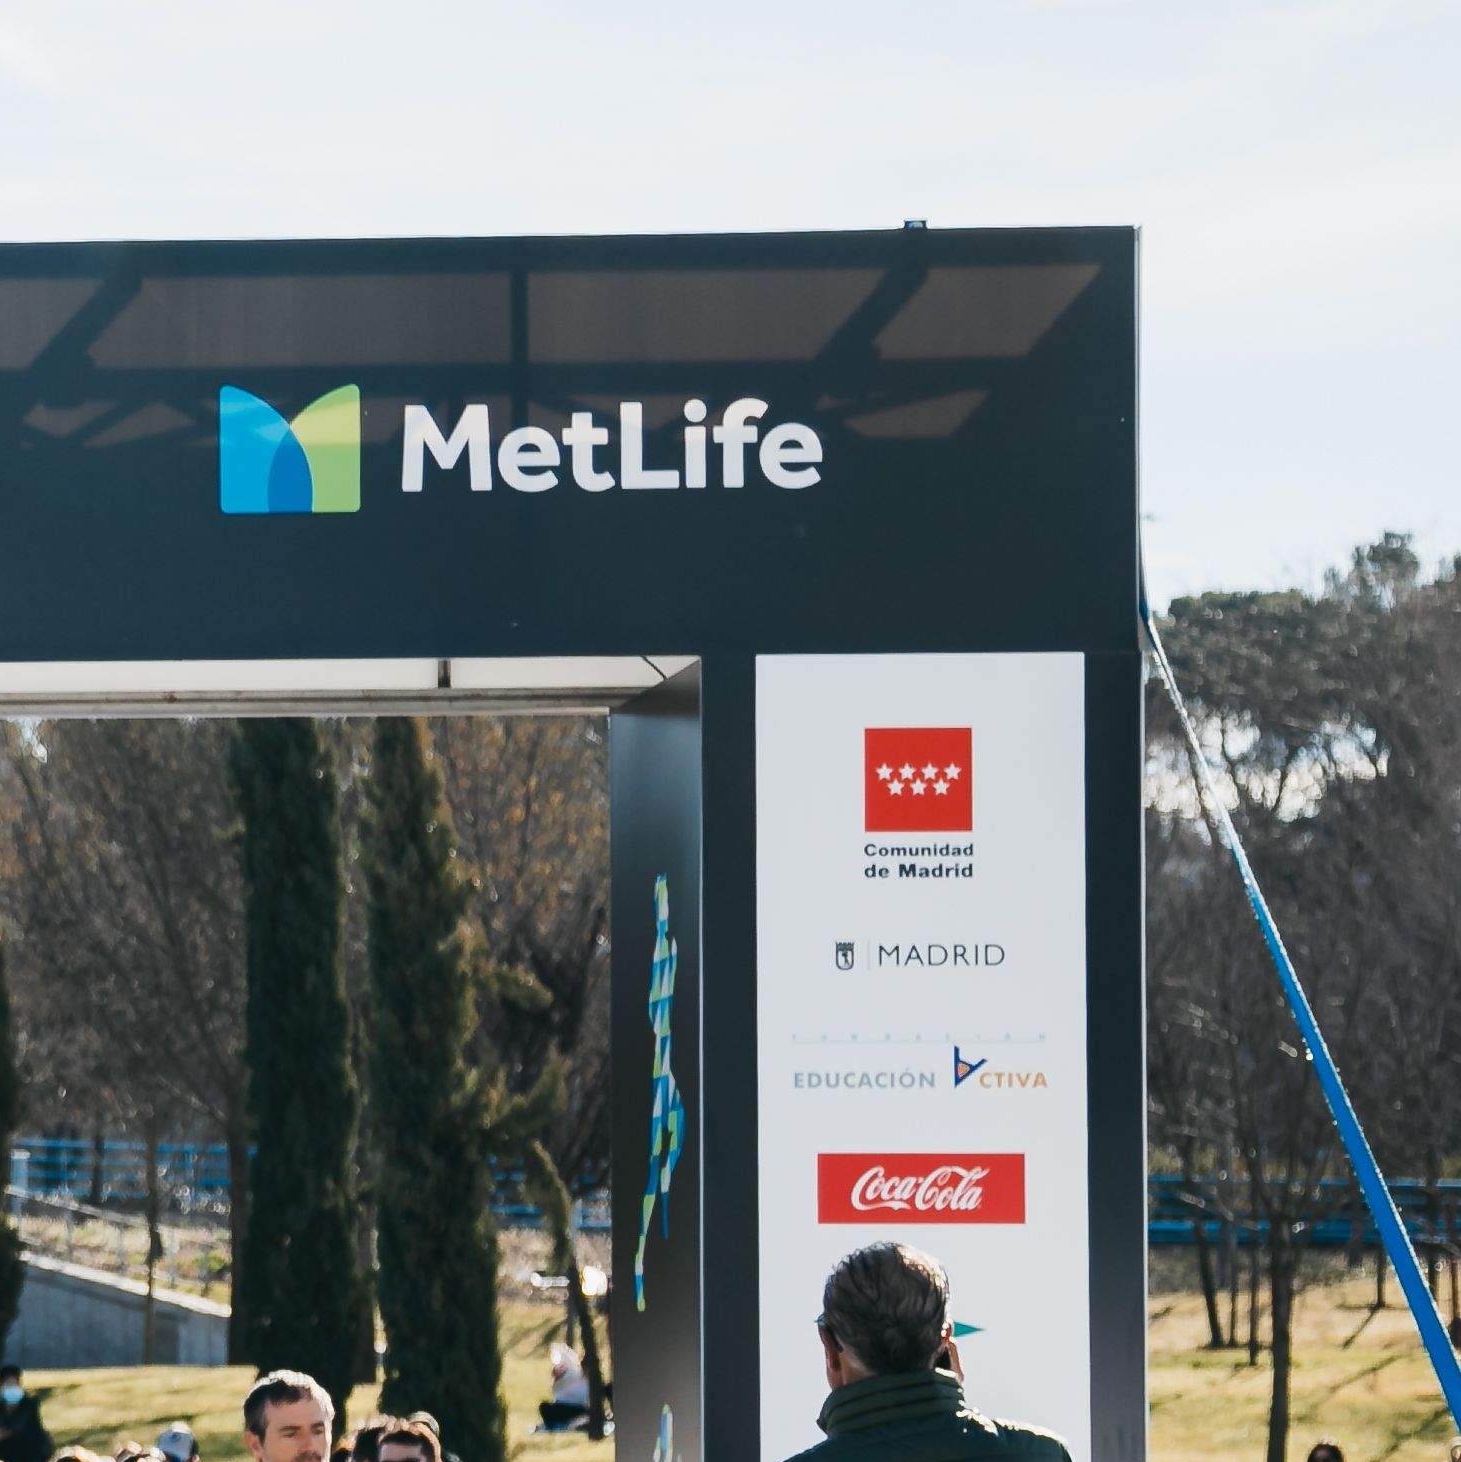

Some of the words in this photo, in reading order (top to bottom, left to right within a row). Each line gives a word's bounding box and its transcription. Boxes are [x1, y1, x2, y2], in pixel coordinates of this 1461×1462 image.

[402, 397, 823, 492] MetLife
[864, 843, 975, 858] Comunidad
[864, 864, 890, 879] de
[898, 864, 974, 879] Madrid
[878, 944, 1006, 967] MADRID
[793, 1068, 937, 1089] EDUCACIÓN
